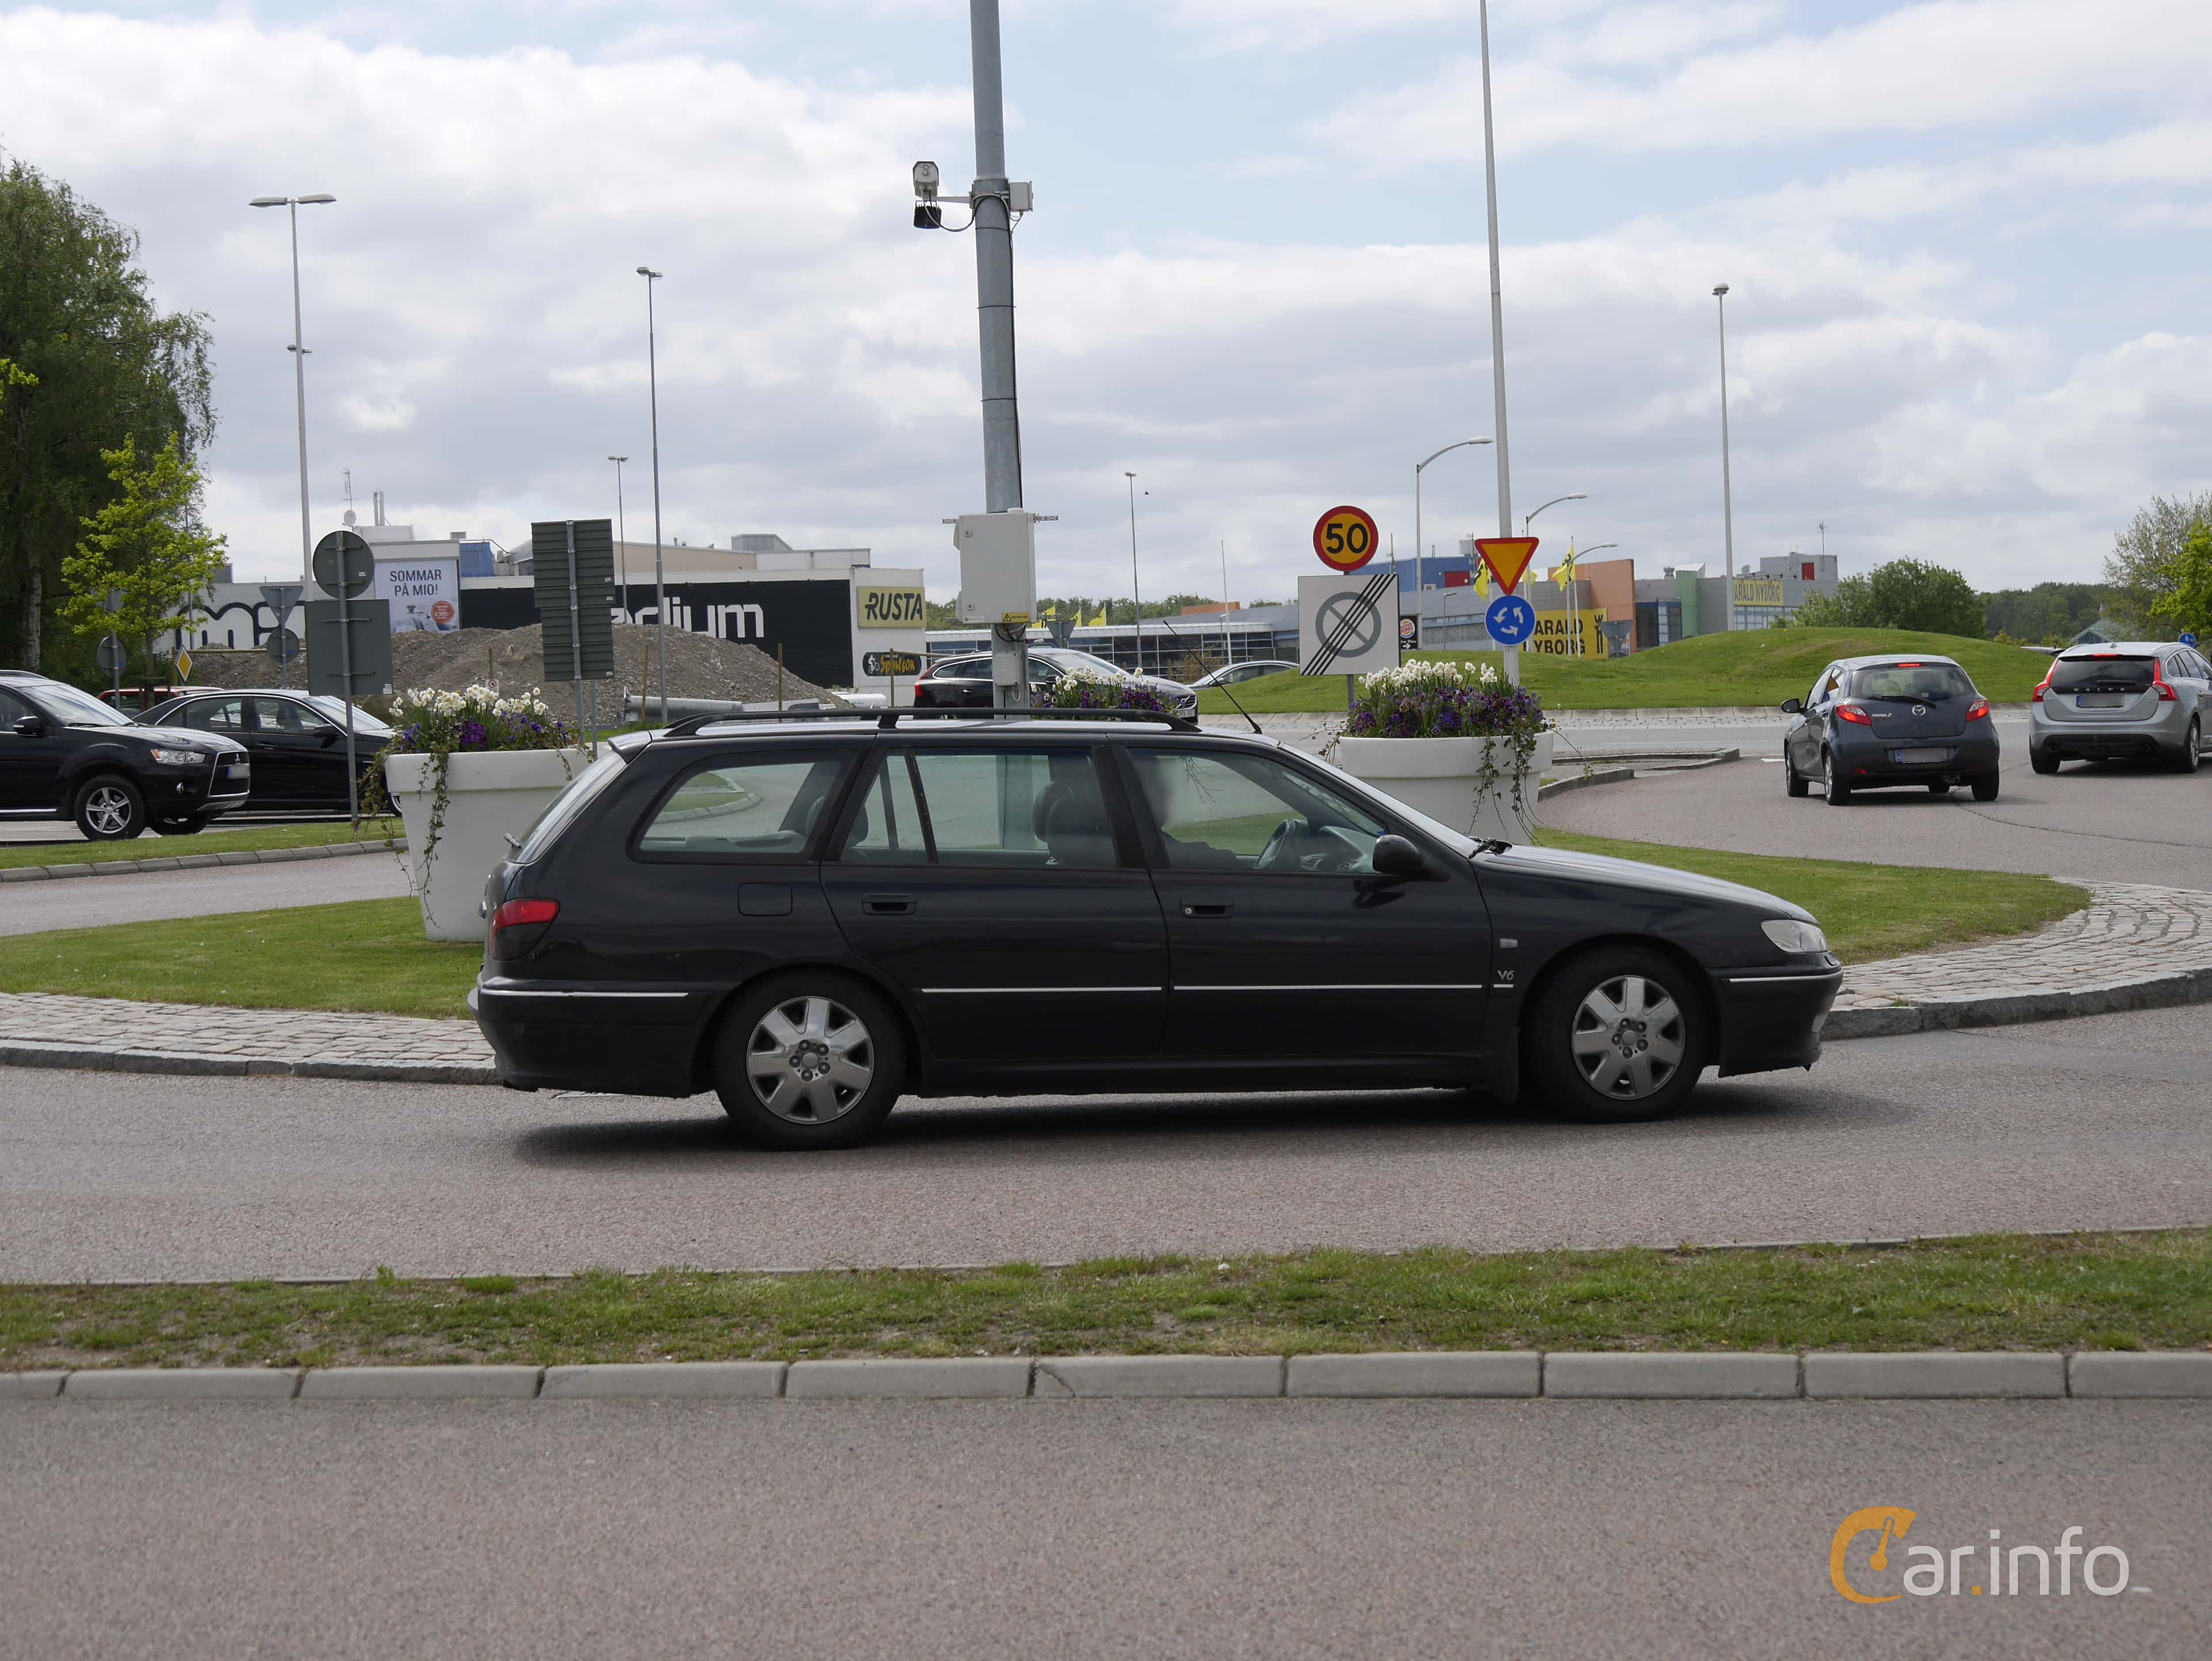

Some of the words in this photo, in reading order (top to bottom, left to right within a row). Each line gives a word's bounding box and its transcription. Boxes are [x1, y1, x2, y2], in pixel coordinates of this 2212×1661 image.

[1326, 523, 1368, 554] 50
[390, 569, 442, 582] SOMMAR
[395, 582, 409, 596] PÅ
[413, 584, 438, 596] MIO!
[1734, 584, 1754, 601] ARALD
[1756, 584, 1780, 603] NYBORG
[865, 593, 923, 620] RUSTA
[1534, 619, 1584, 636] ARALD
[880, 654, 915, 674] Sprtson
[1497, 970, 1514, 980] V6
